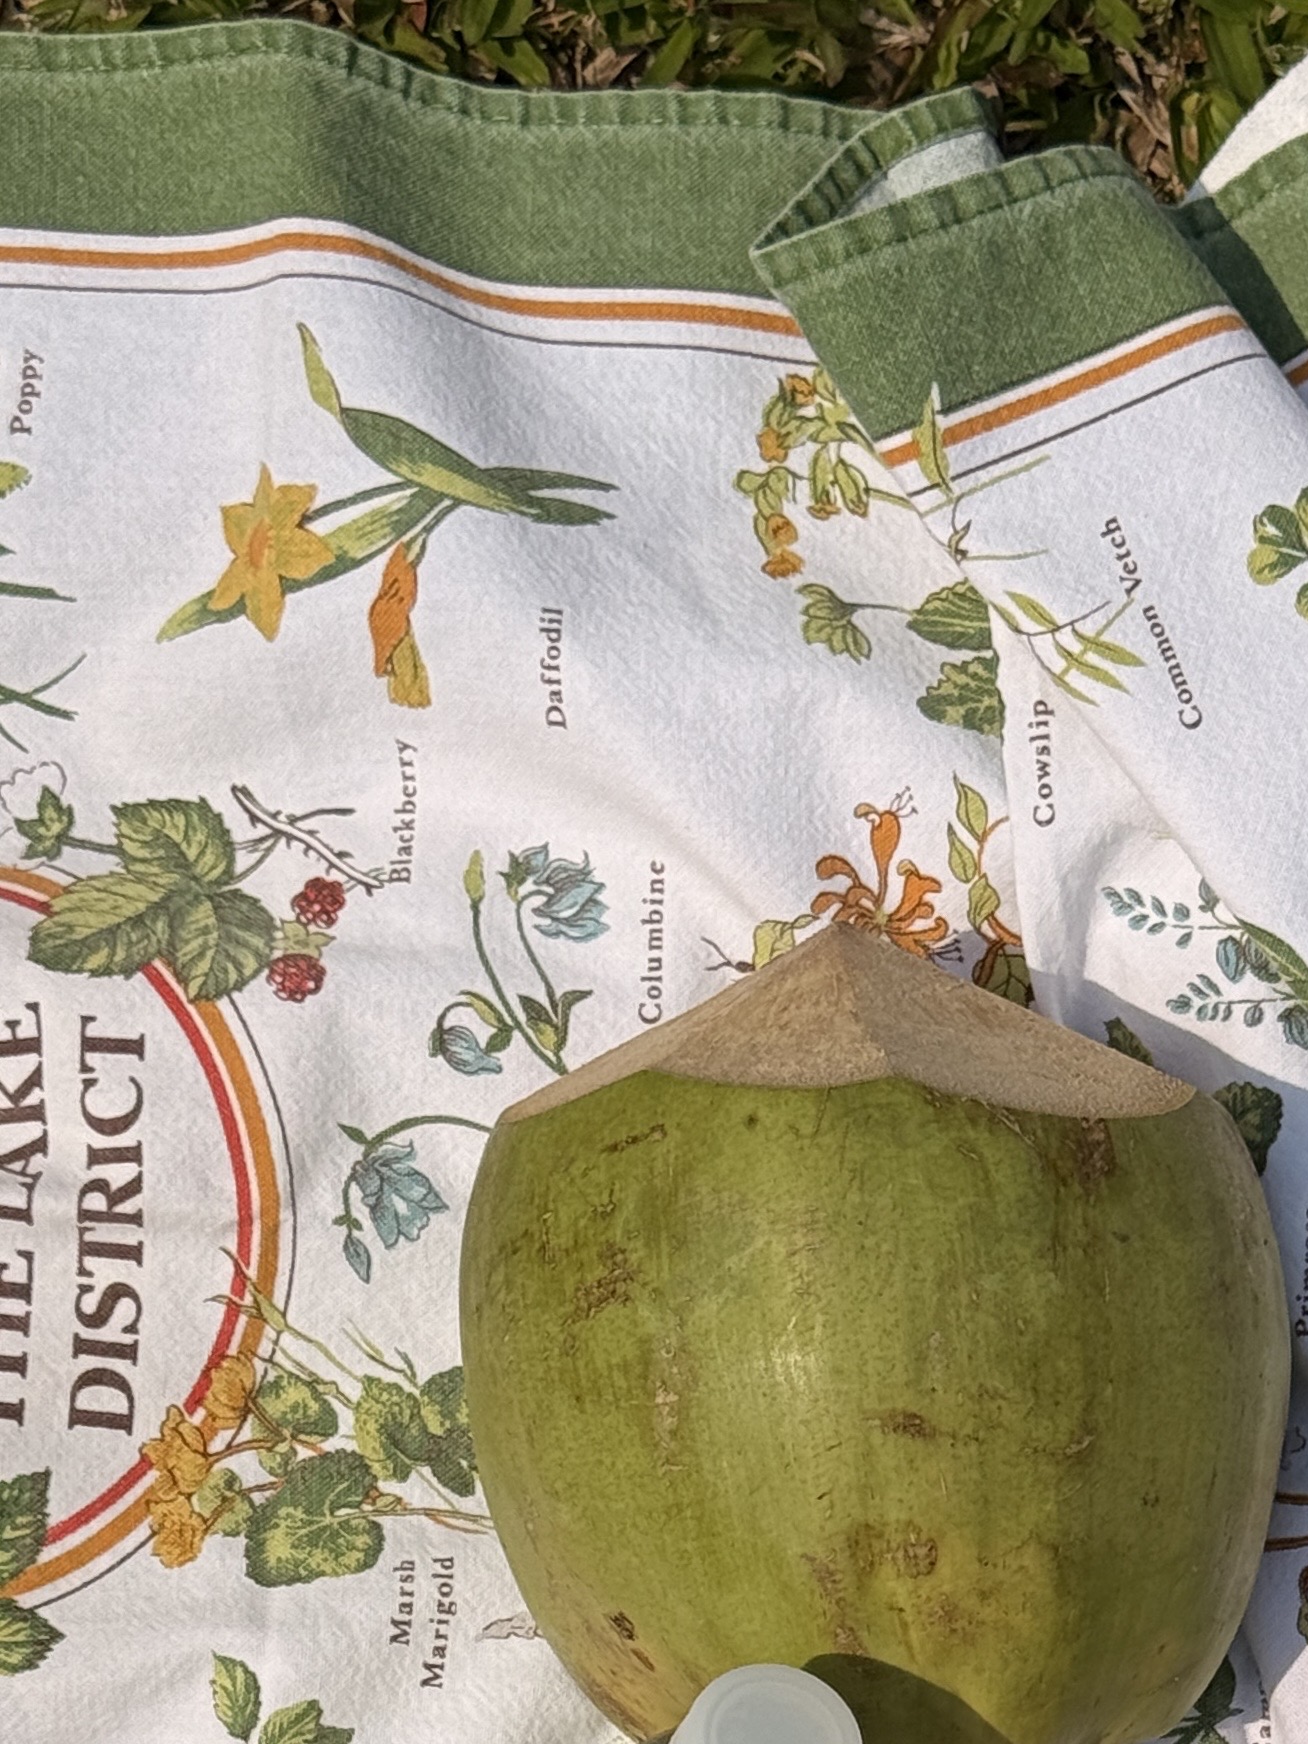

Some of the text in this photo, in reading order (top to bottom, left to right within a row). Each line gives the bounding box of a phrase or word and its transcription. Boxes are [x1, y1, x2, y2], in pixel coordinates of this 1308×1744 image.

[9, 348, 45, 436] Poppy
[538, 606, 568, 731] Daffodil
[1100, 515, 1203, 730] Common Vetch
[389, 737, 418, 884] Blackberry
[1027, 699, 1056, 828] Cowslip
[637, 859, 667, 1026] Columbine
[67, 1013, 146, 1437] DISTRICT
[388, 1557, 415, 1647] Marsh
[419, 1555, 455, 1690] Marigold
